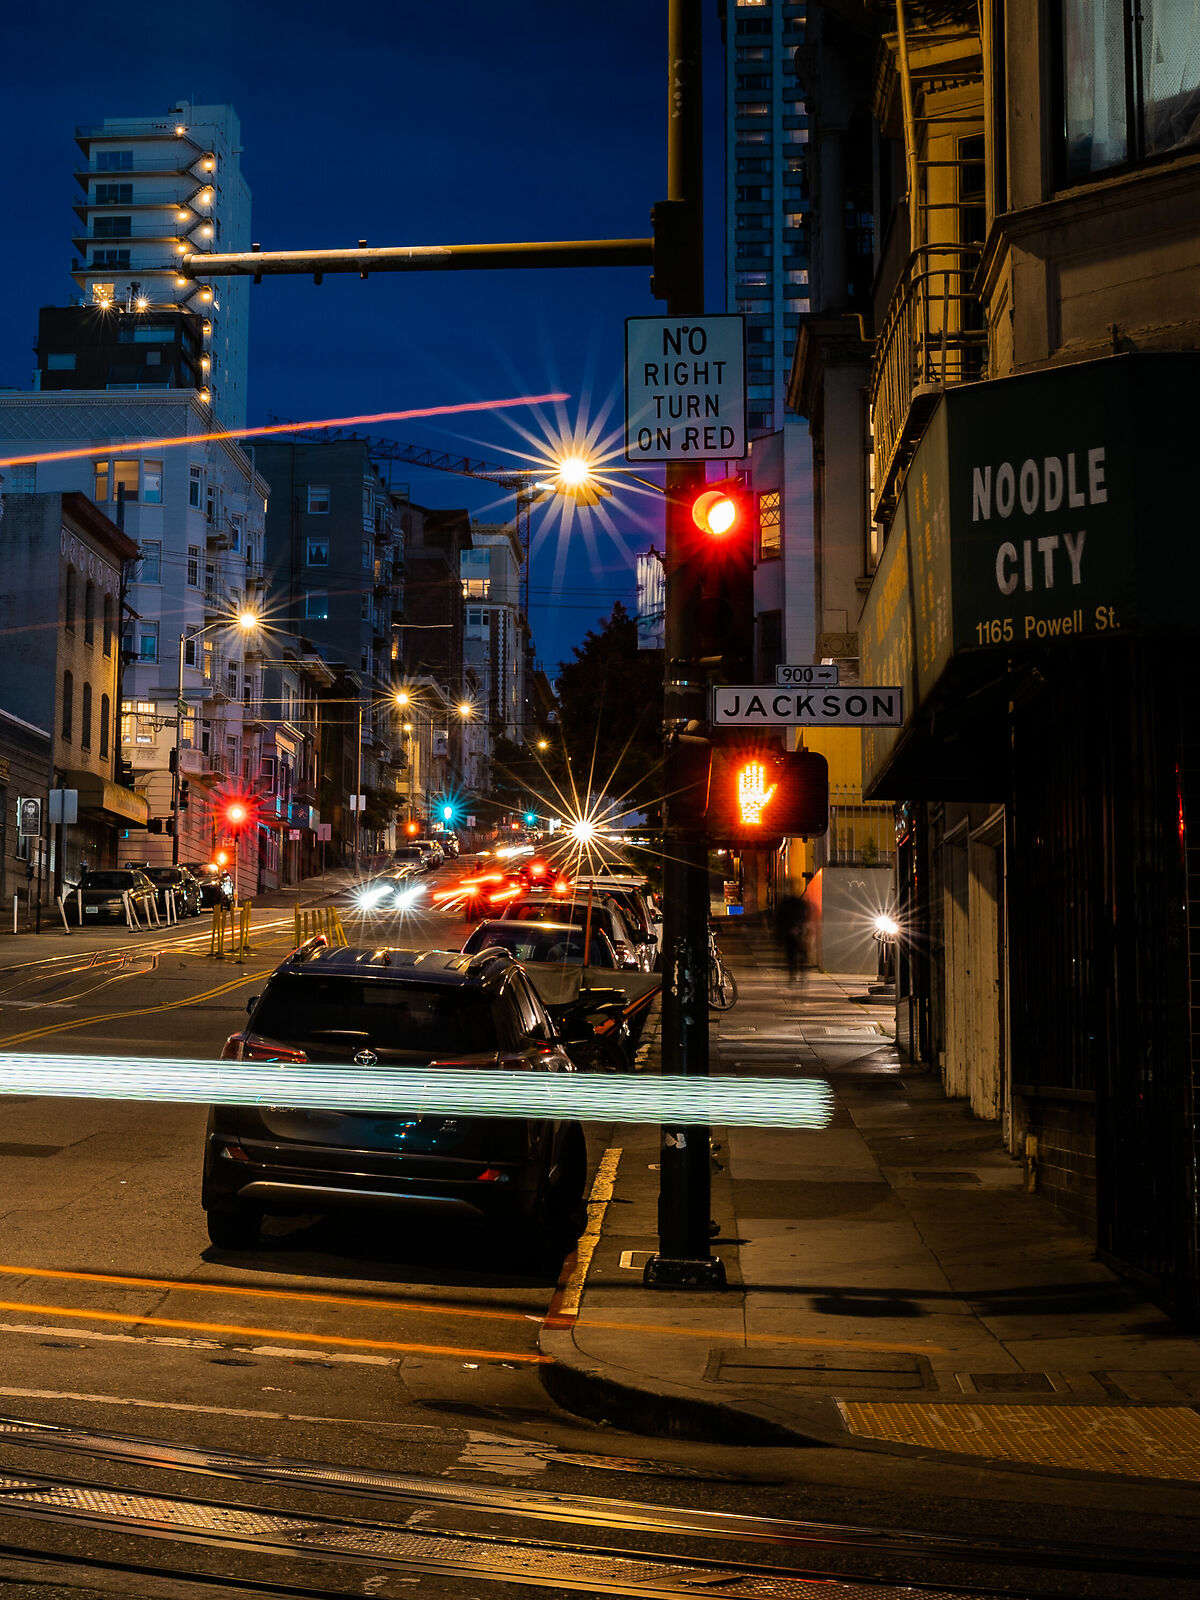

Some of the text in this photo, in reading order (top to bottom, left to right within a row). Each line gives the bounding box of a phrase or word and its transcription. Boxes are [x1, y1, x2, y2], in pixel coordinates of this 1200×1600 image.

[662, 326, 707, 356] NO
[644, 361, 726, 386] RIGHT
[653, 394, 719, 419] TURN
[638, 426, 735, 451] ON RED
[972, 447, 1108, 522] NOODLE
[995, 530, 1087, 595] CITY
[976, 606, 1121, 645] 1165 Powell St.
[782, 667, 814, 683] 900
[723, 695, 894, 717] JACKSON
